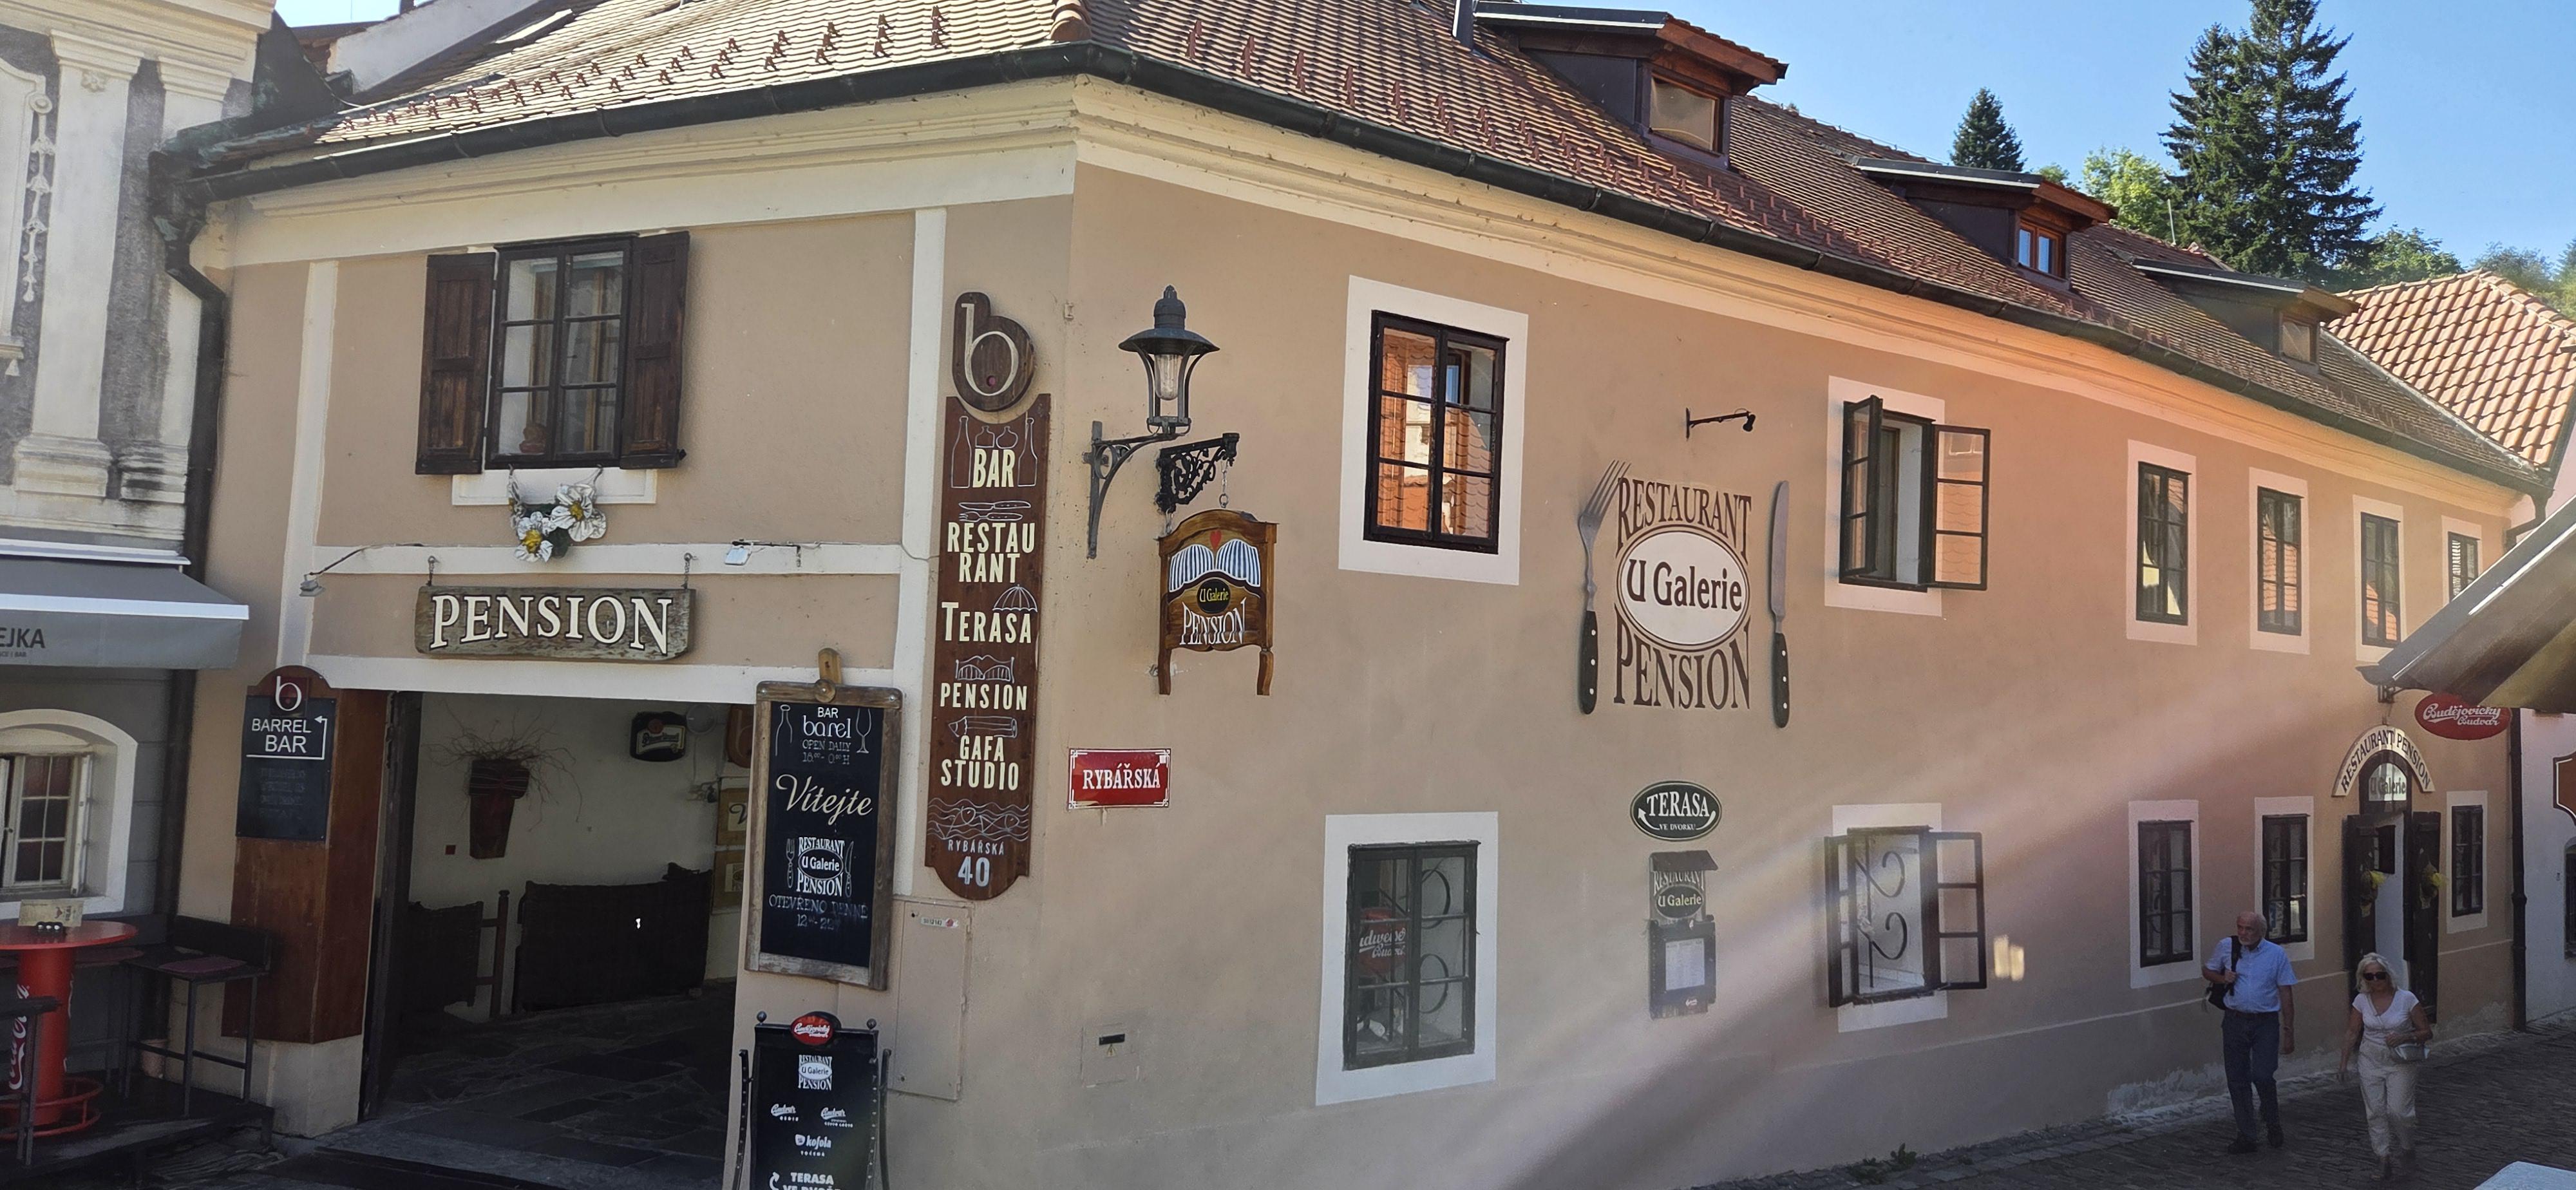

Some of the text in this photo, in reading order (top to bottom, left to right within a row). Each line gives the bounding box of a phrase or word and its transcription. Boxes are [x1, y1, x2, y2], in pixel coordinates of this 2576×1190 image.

[972, 449, 1016, 488] BAR
[1615, 477, 1752, 566] RESTAURANT
[947, 522, 1036, 554] RESTAU
[959, 552, 1021, 583] RANT
[1199, 588, 1229, 602] U Galerie
[1626, 559, 1743, 612] U Galerie
[430, 594, 672, 655] PENSION
[941, 601, 1032, 644] TERASA
[1179, 597, 1247, 645] PENSION
[1613, 602, 1751, 710] PENSION
[940, 683, 1027, 711] PENSION
[251, 718, 312, 733] BARREL
[817, 706, 838, 718] BAR
[2458, 715, 2500, 726] Budvar
[802, 715, 851, 738] barel
[265, 734, 307, 753] BAR
[802, 739, 826, 750] OPEN
[960, 735, 1005, 762] GAFA
[941, 759, 1019, 791] STUDIO
[2340, 730, 2431, 793] RESTAURANT PENSION
[1083, 762, 1160, 789] RYBÁŘSKÁ
[775, 773, 874, 826] Vítejte
[1647, 791, 1710, 817] TERASA
[798, 836, 845, 858] RESTAURANT
[801, 856, 840, 871] U Galerie
[958, 856, 990, 887] 40
[796, 867, 844, 897] PENSION
[1658, 893, 1702, 907] U Galerie
[799, 1054, 833, 1066] RESTAURANT
[808, 1066, 829, 1075] Galerie
[798, 1076, 832, 1091] PENSION
[806, 1135, 832, 1149] kofola
[790, 1172, 834, 1185] TERASA
